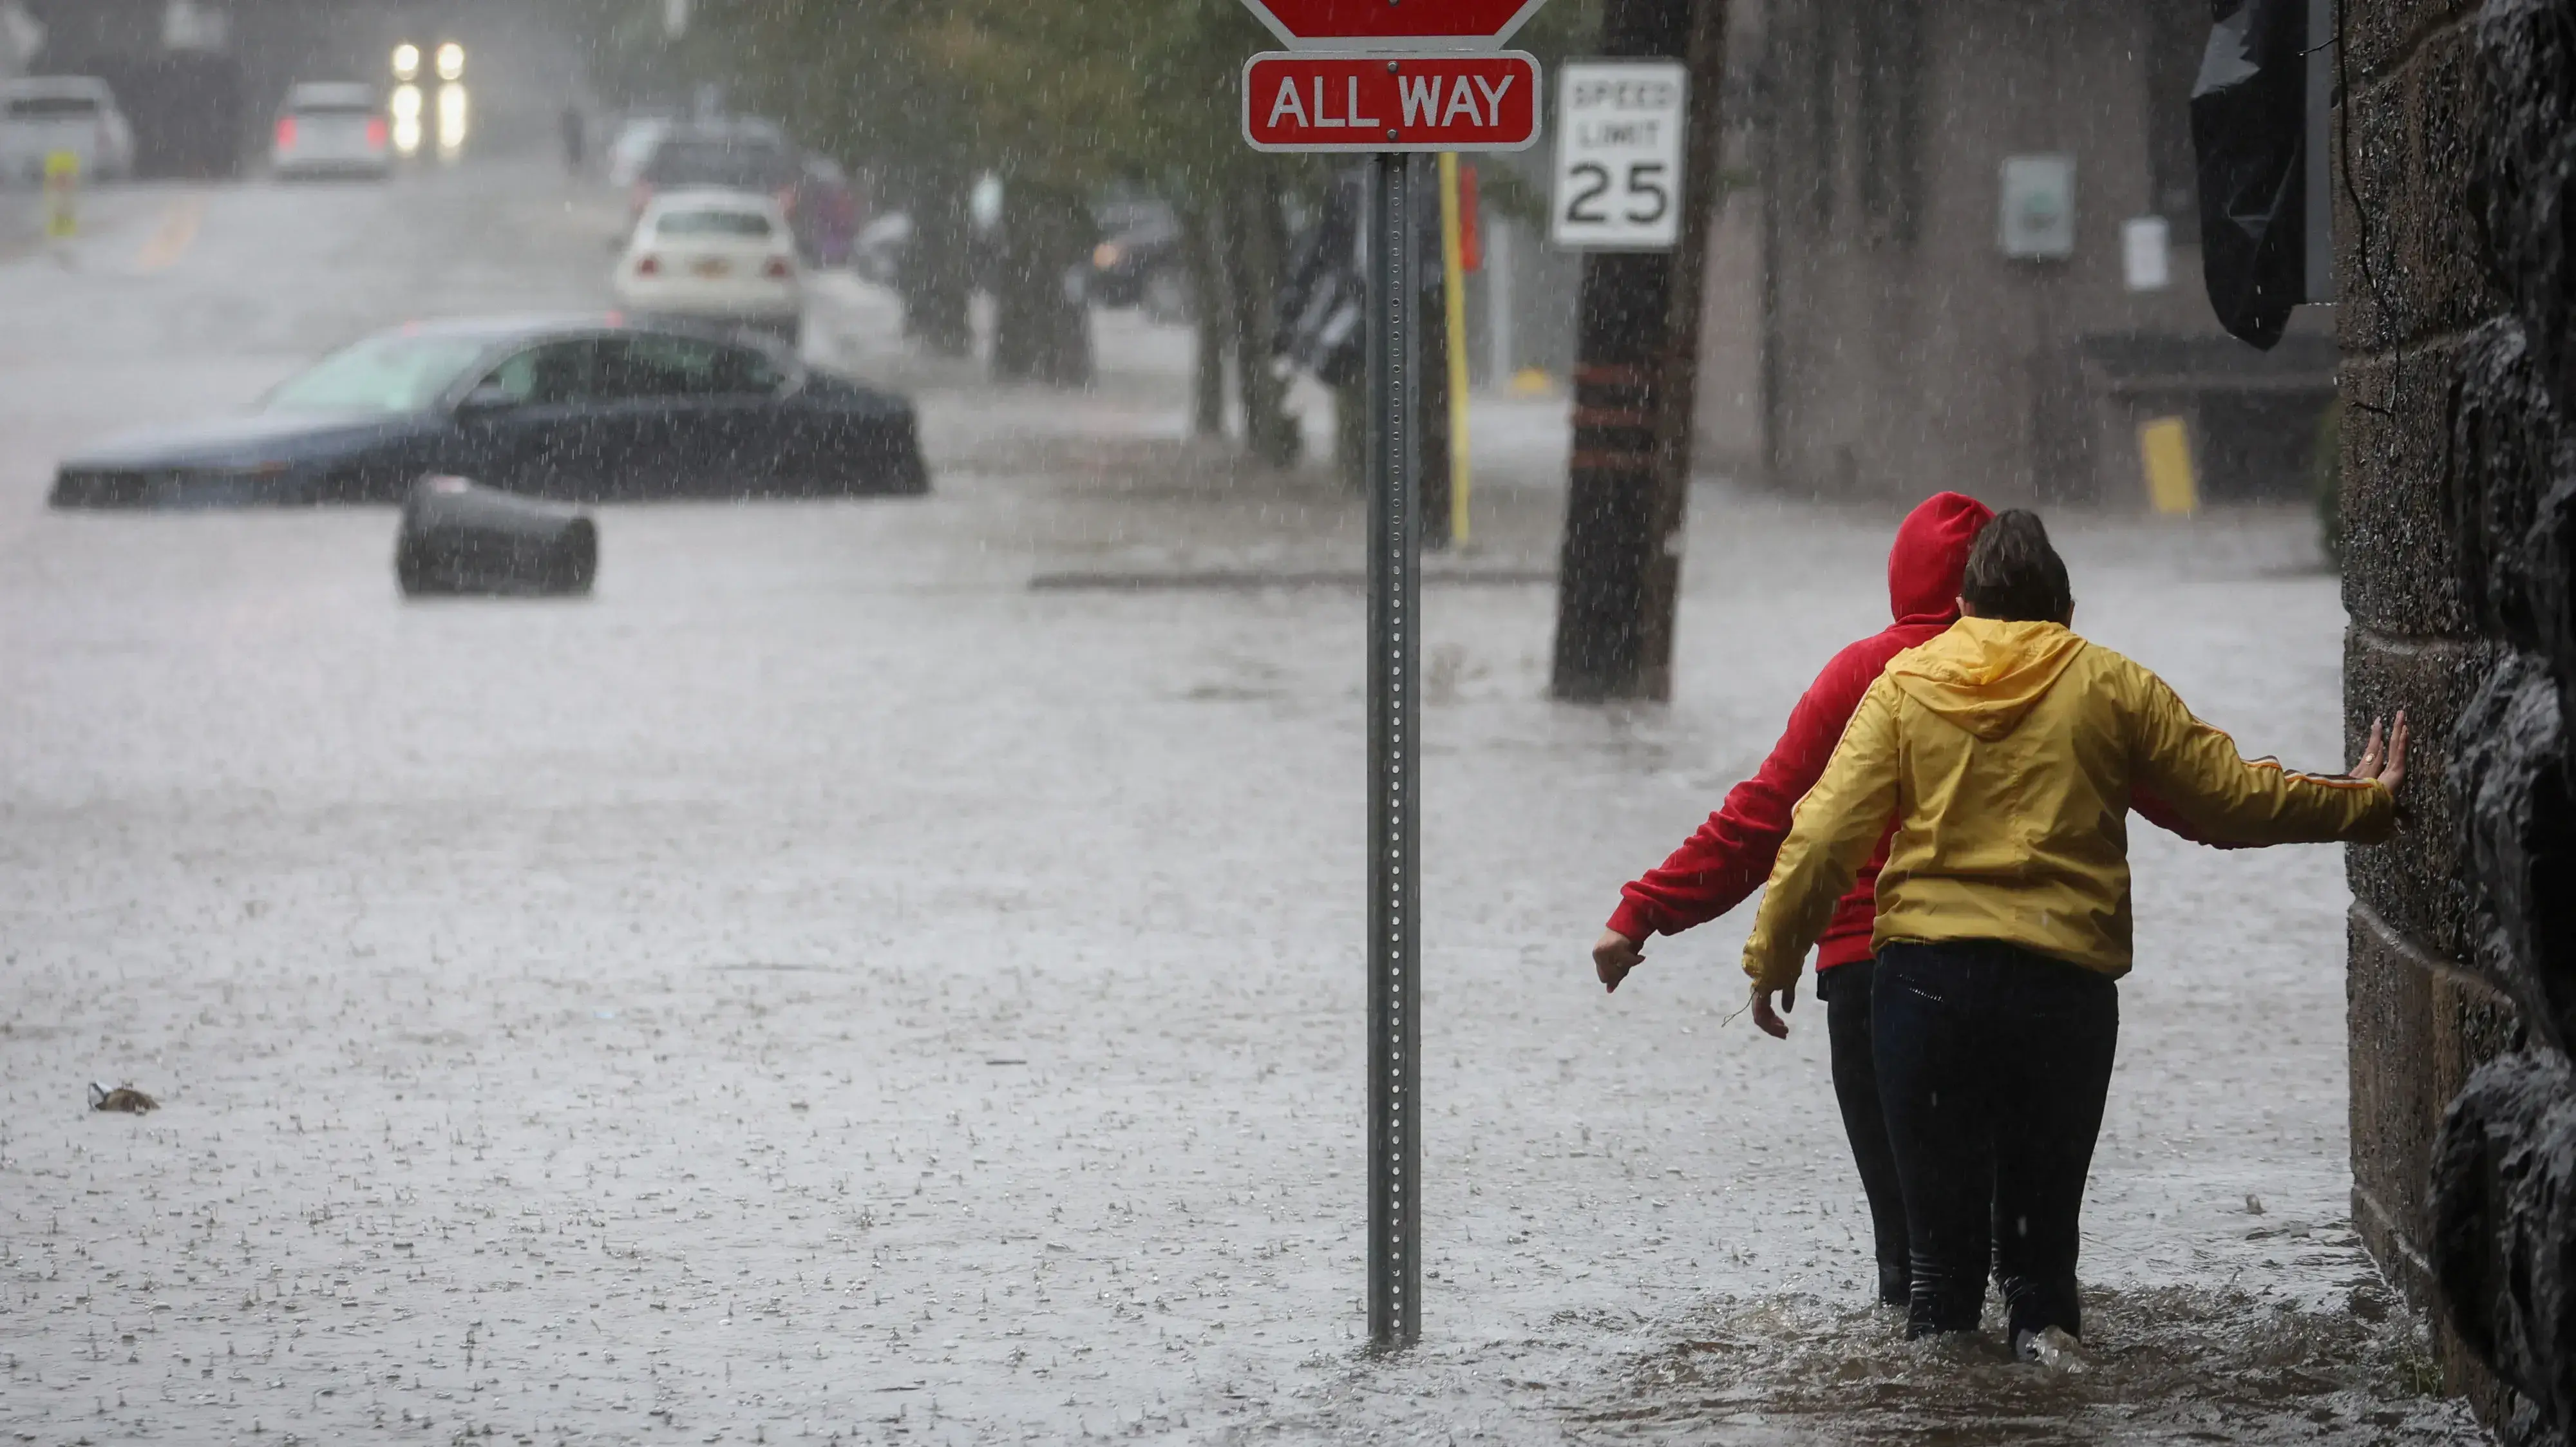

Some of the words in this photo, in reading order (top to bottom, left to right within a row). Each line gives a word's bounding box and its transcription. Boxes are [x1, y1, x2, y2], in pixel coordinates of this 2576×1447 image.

[1266, 75, 1380, 128] ALL
[1397, 75, 1515, 127] WAY
[1573, 80, 1673, 109] SPEED
[1577, 120, 1660, 149] LIMIT
[1565, 162, 1667, 224] 25
